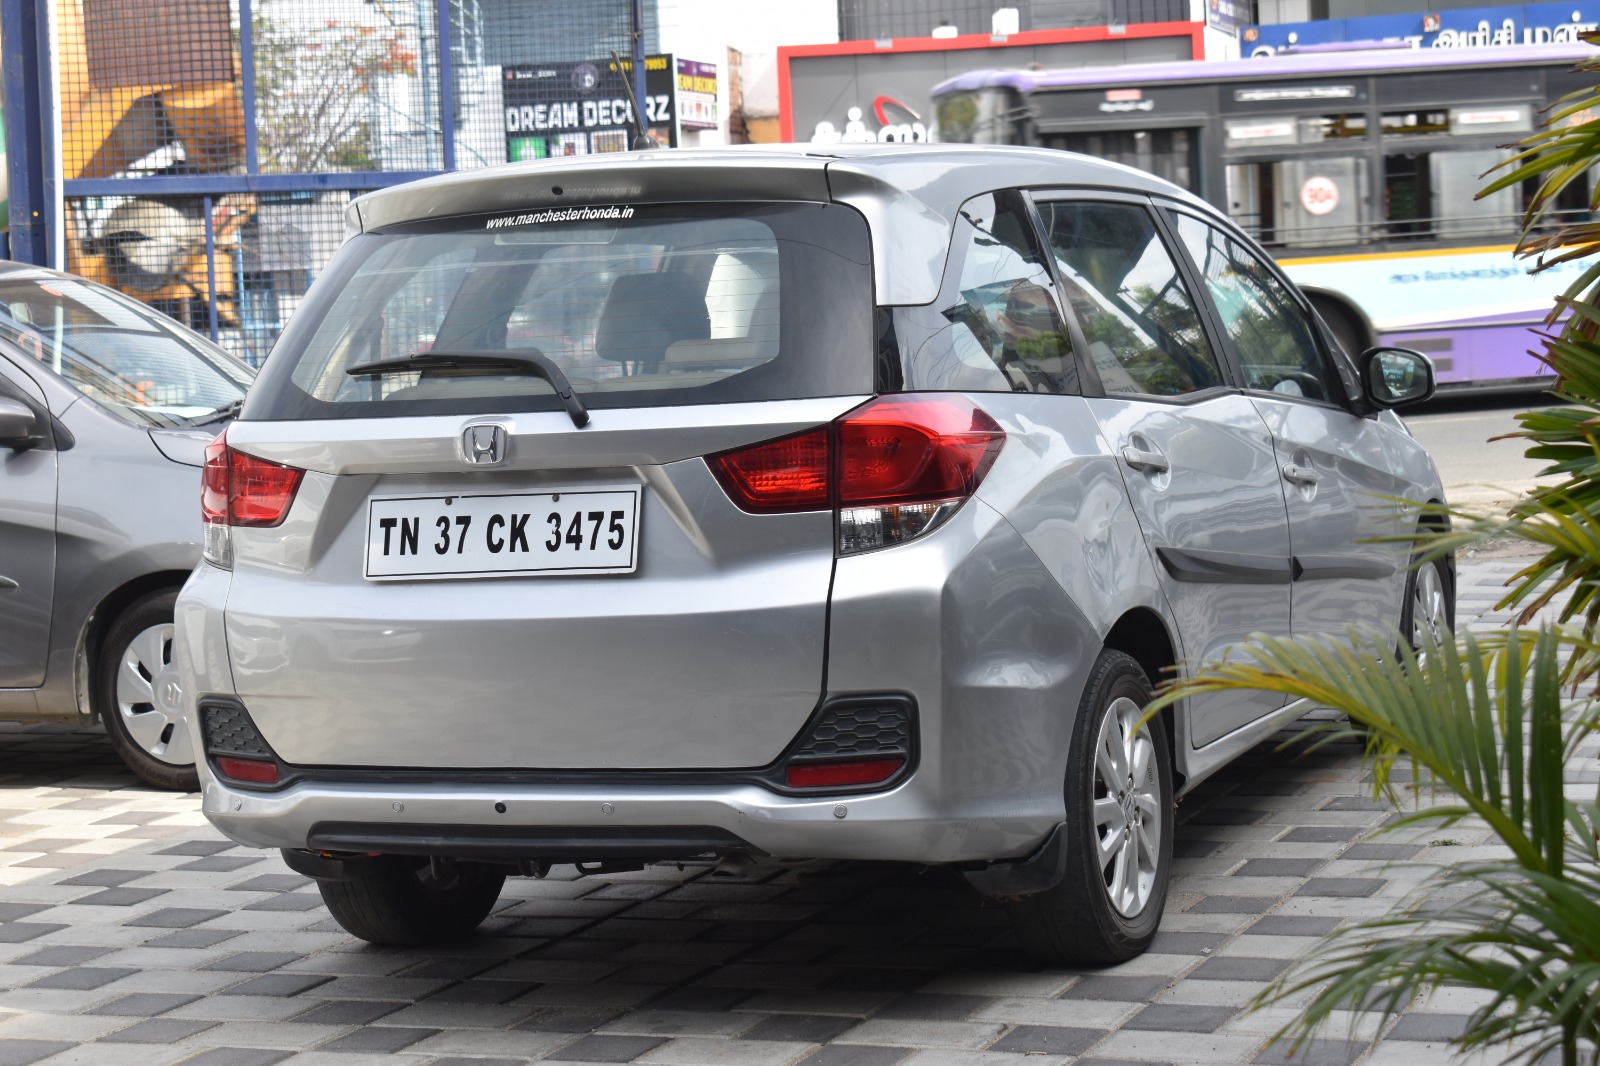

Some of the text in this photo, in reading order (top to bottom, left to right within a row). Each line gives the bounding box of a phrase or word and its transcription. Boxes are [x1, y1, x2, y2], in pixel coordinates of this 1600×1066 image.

[506, 102, 579, 132] DREAM
[486, 206, 635, 229] www.manchesterhonda.in
[379, 510, 625, 556] TN 37 CK 3475
